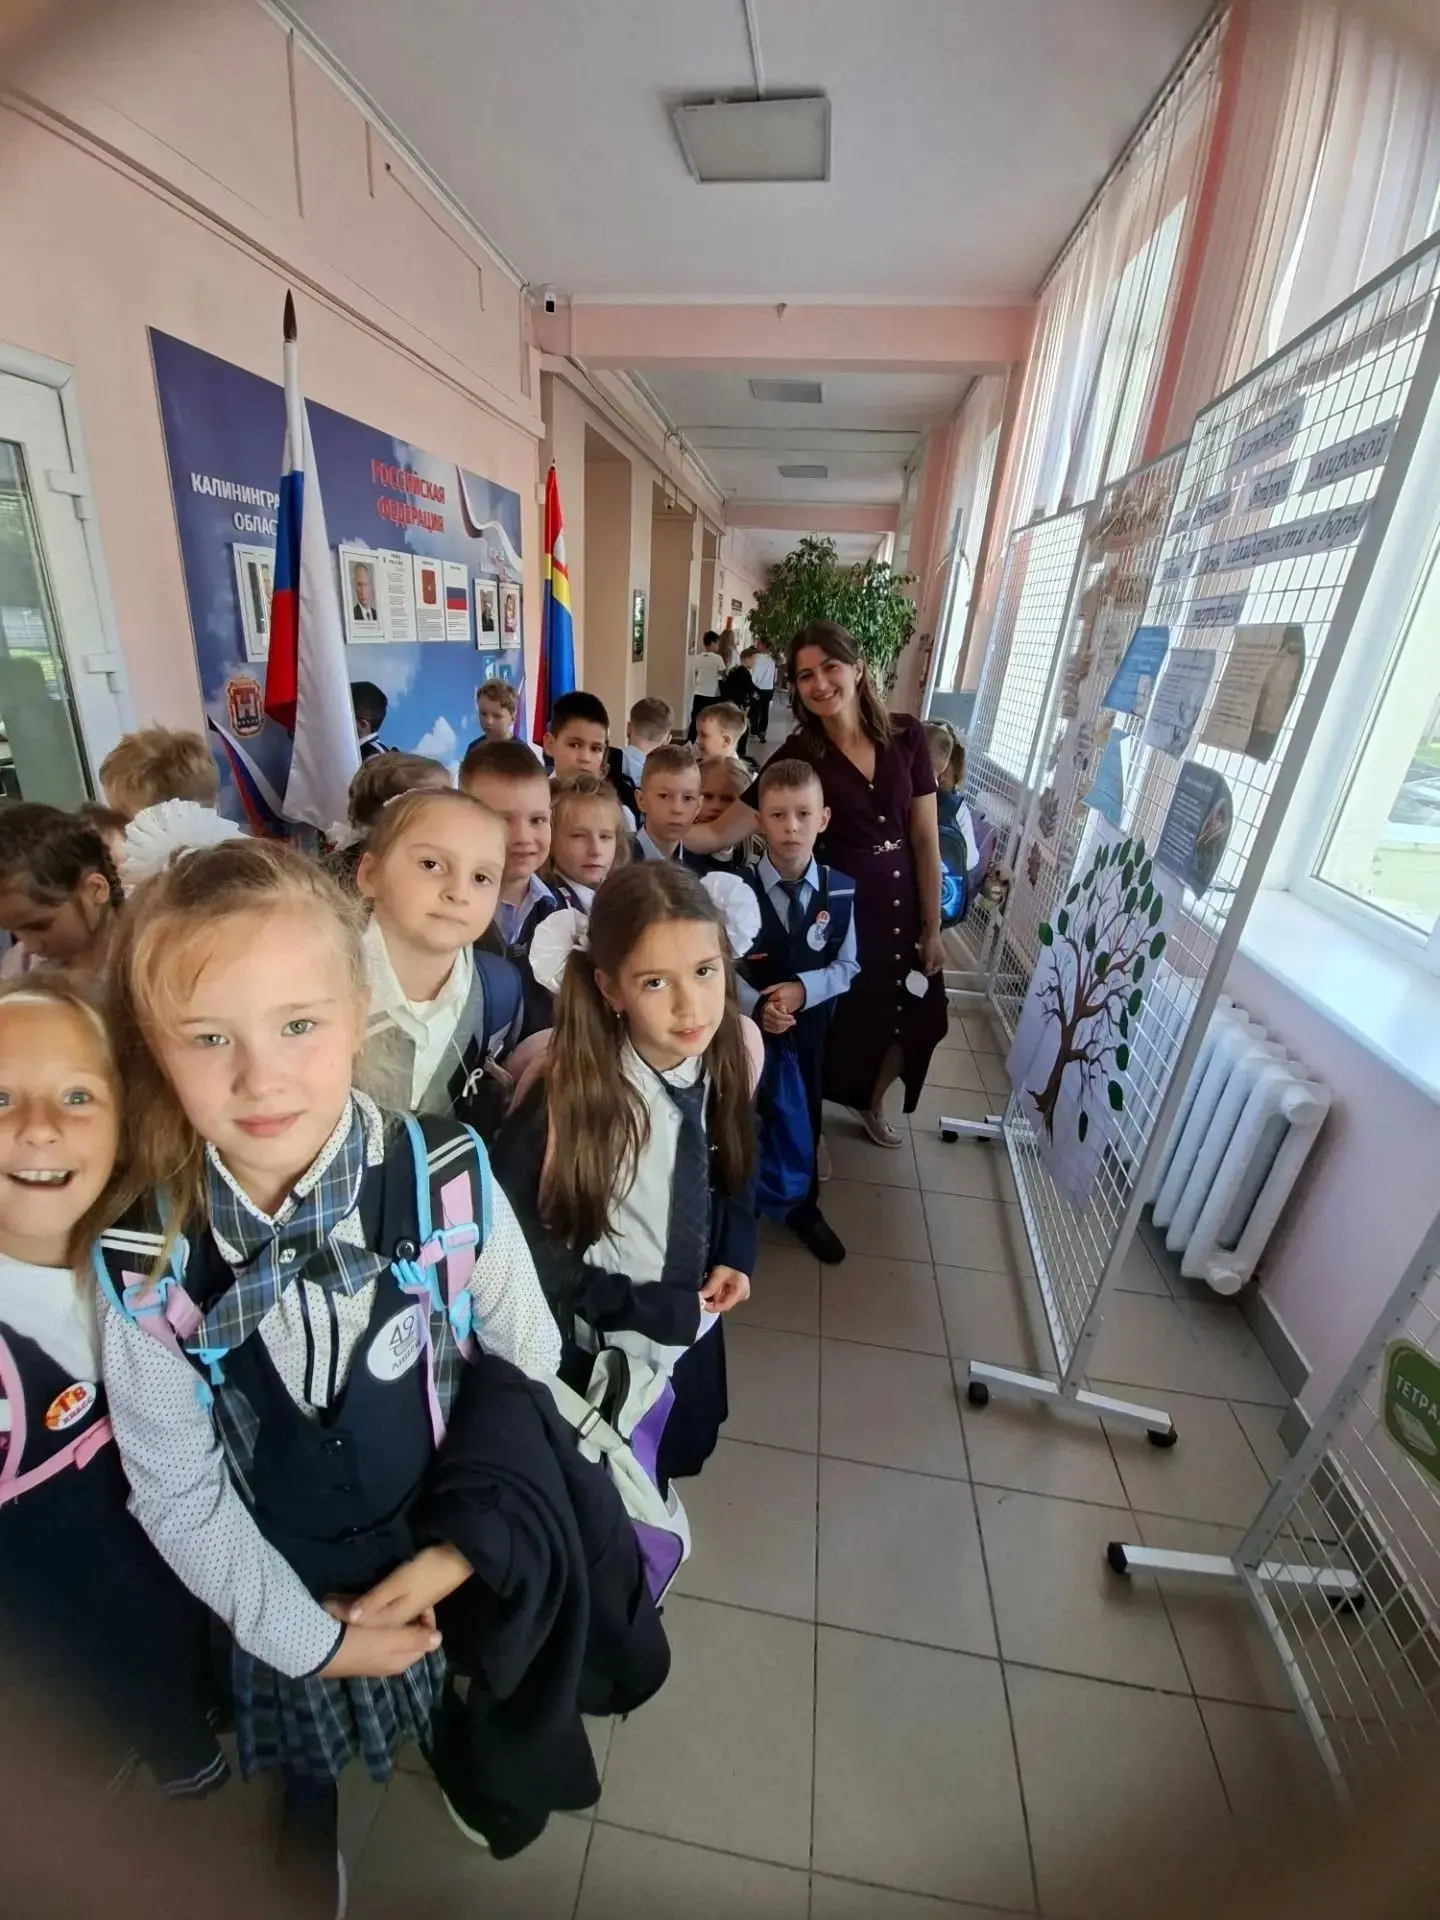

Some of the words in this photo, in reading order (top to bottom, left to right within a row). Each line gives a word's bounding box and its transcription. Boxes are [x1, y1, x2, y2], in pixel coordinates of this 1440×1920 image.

[1310, 428, 1389, 484] мировой
[371, 458, 445, 505] РОССИЙСКАЯ
[377, 495, 444, 536] ФЕДЕРАЦИЯ
[1395, 1373, 1440, 1427] ТЕТРА
